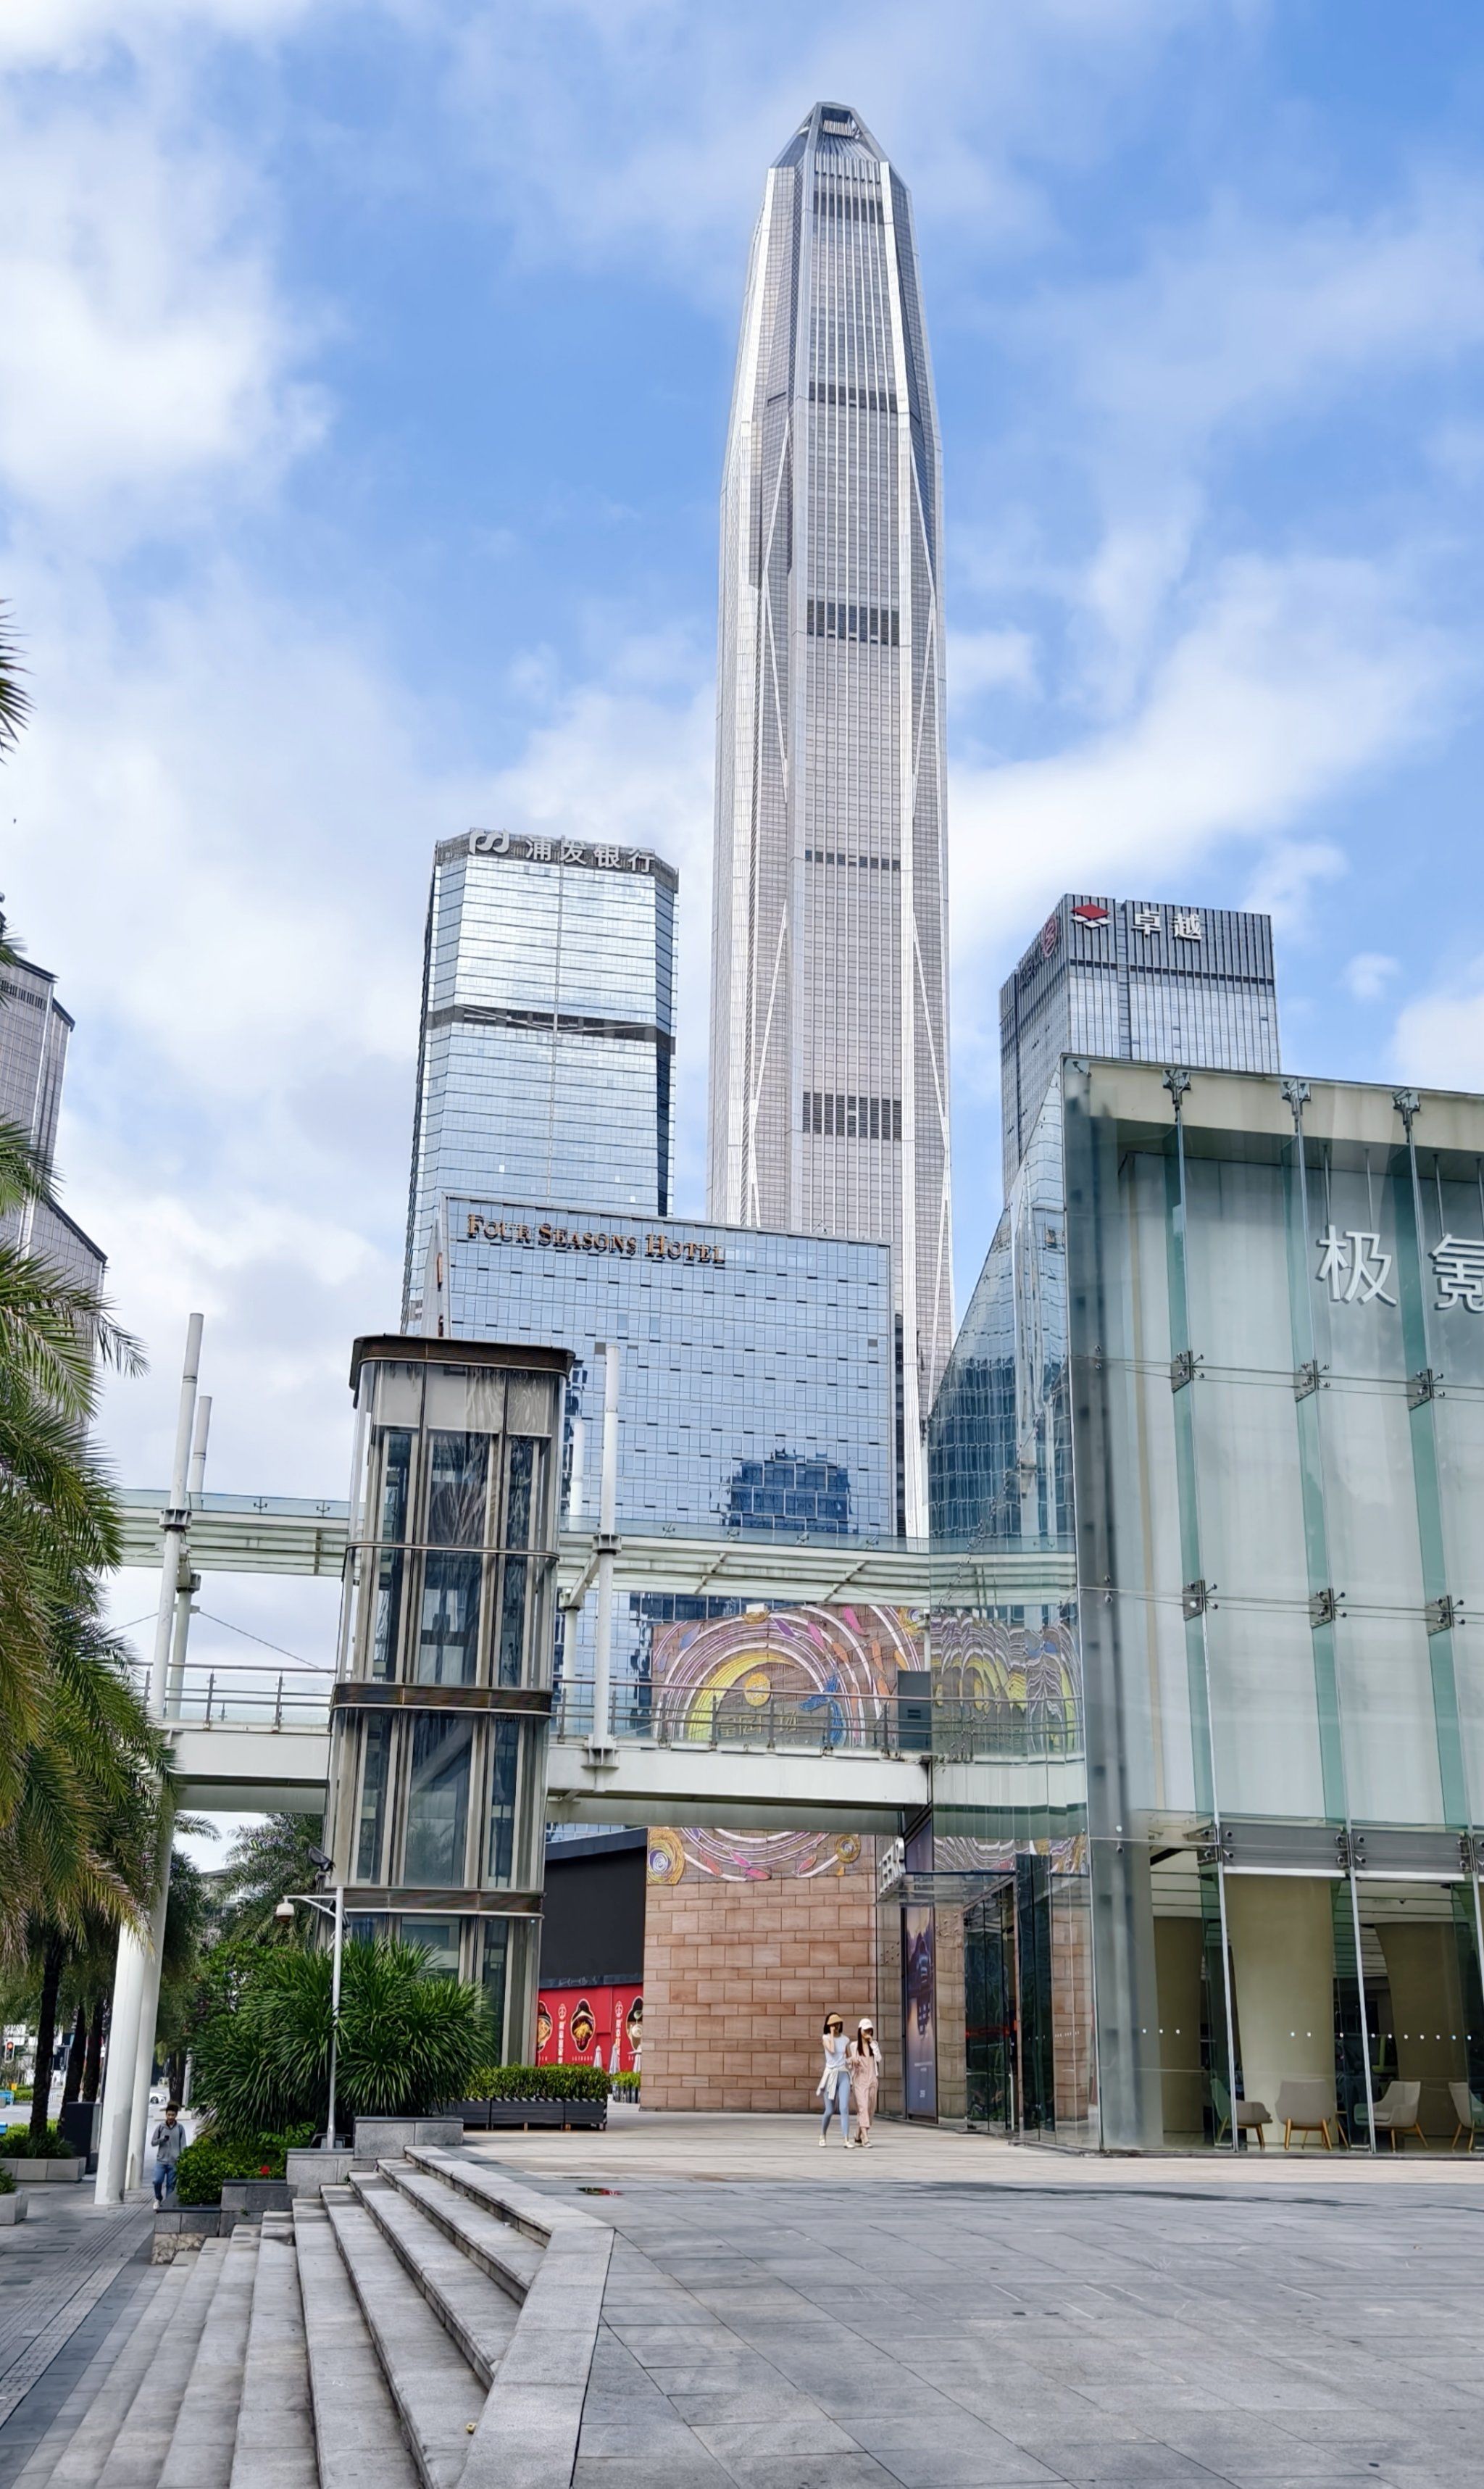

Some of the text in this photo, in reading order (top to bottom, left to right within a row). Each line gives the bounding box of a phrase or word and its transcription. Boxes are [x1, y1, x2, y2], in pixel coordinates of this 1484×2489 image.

[525, 835, 655, 873] 浦发银行
[1132, 908, 1203, 941] 卓越
[1316, 1225, 1484, 1312] 极氪
